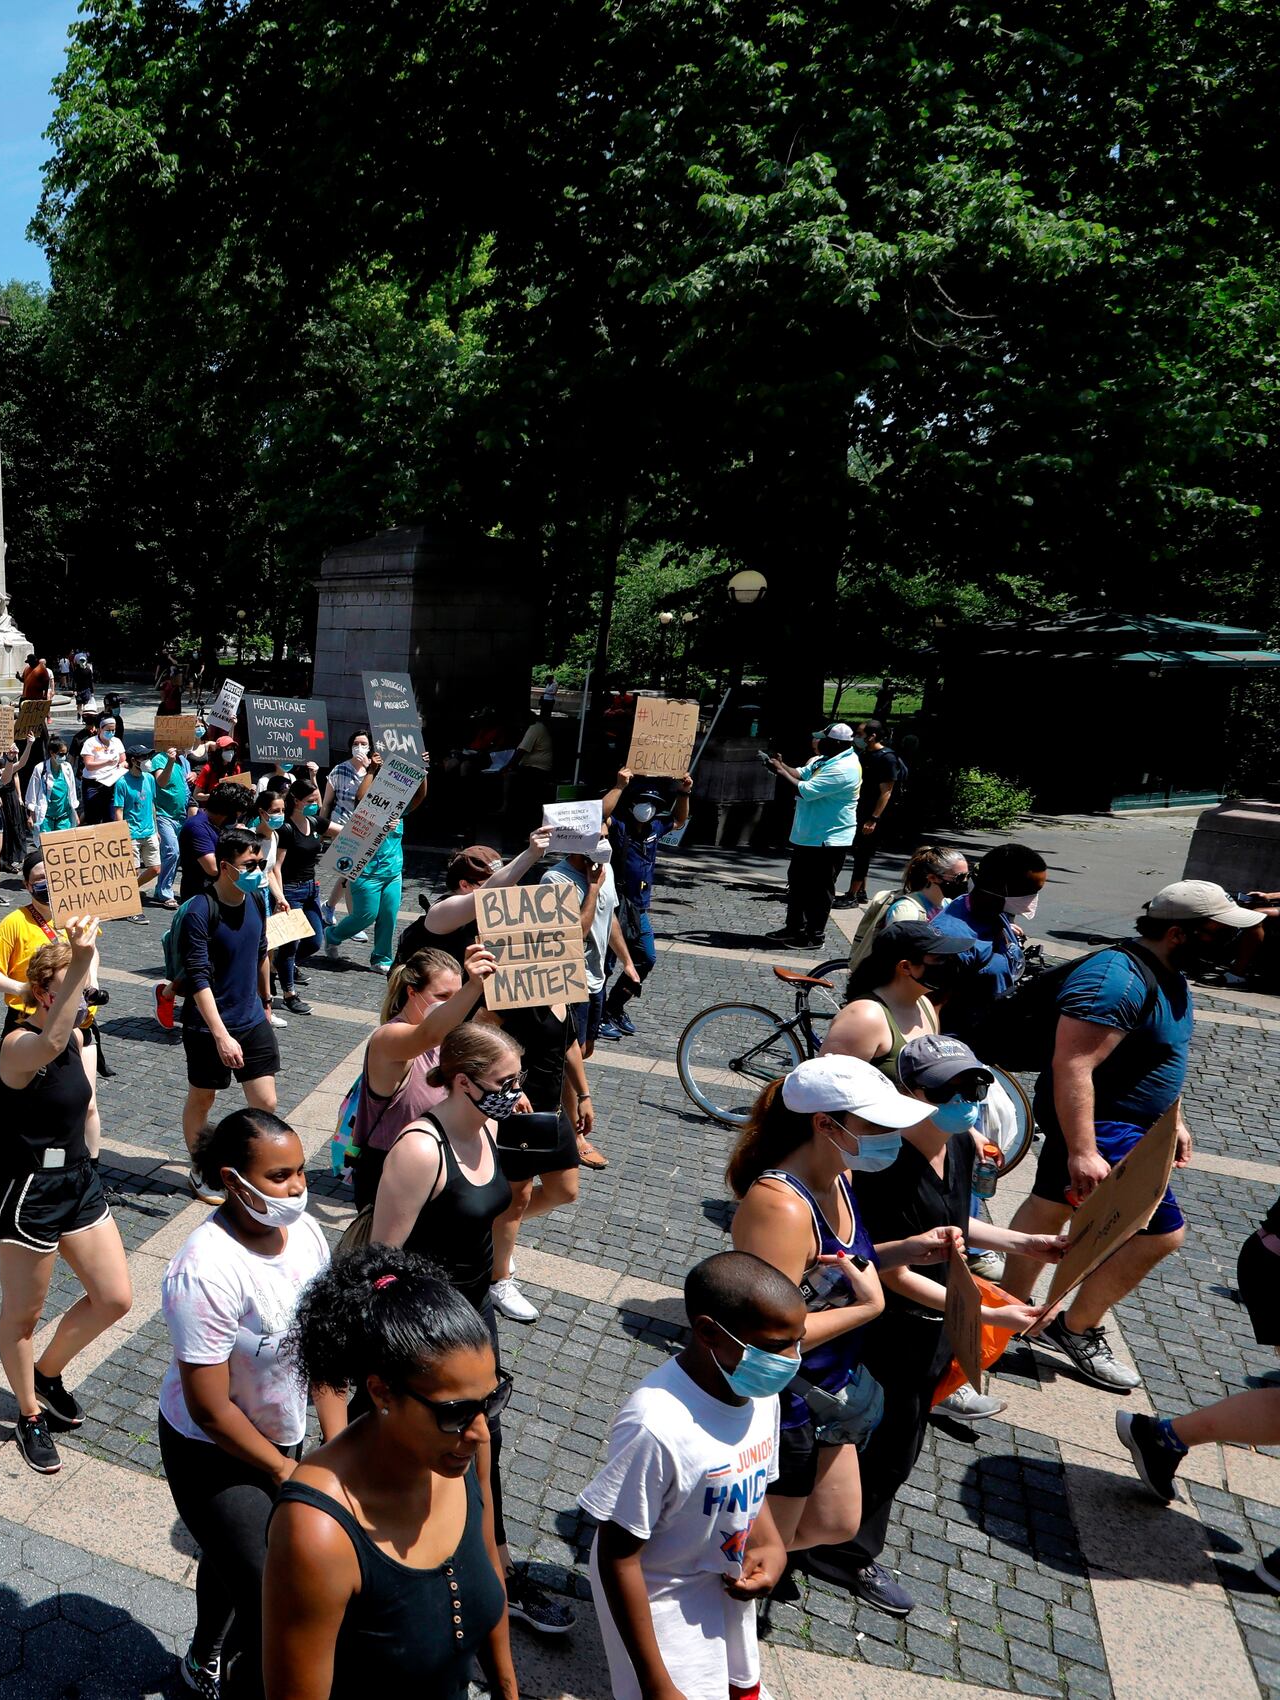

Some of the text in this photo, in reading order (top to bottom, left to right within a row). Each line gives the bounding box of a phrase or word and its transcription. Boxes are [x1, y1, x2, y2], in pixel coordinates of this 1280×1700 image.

[370, 679, 379, 688] NO
[380, 678, 408, 696] STRUGGLE
[252, 698, 307, 714] HEALTHCARE
[373, 700, 382, 709] NO
[255, 716, 295, 729] WORKERS
[266, 731, 294, 743] STAND
[375, 728, 419, 756] #BLM
[256, 745, 279, 757] WITH
[634, 750, 671, 770] BLACK
[366, 792, 391, 811] #BLM
[45, 838, 131, 866] GEORGE
[49, 860, 137, 893] BREONNA
[57, 885, 133, 914] AHMAUD
[481, 884, 580, 929] BLACK
[507, 929, 566, 961] LIVES
[494, 962, 586, 1002] MATTER
